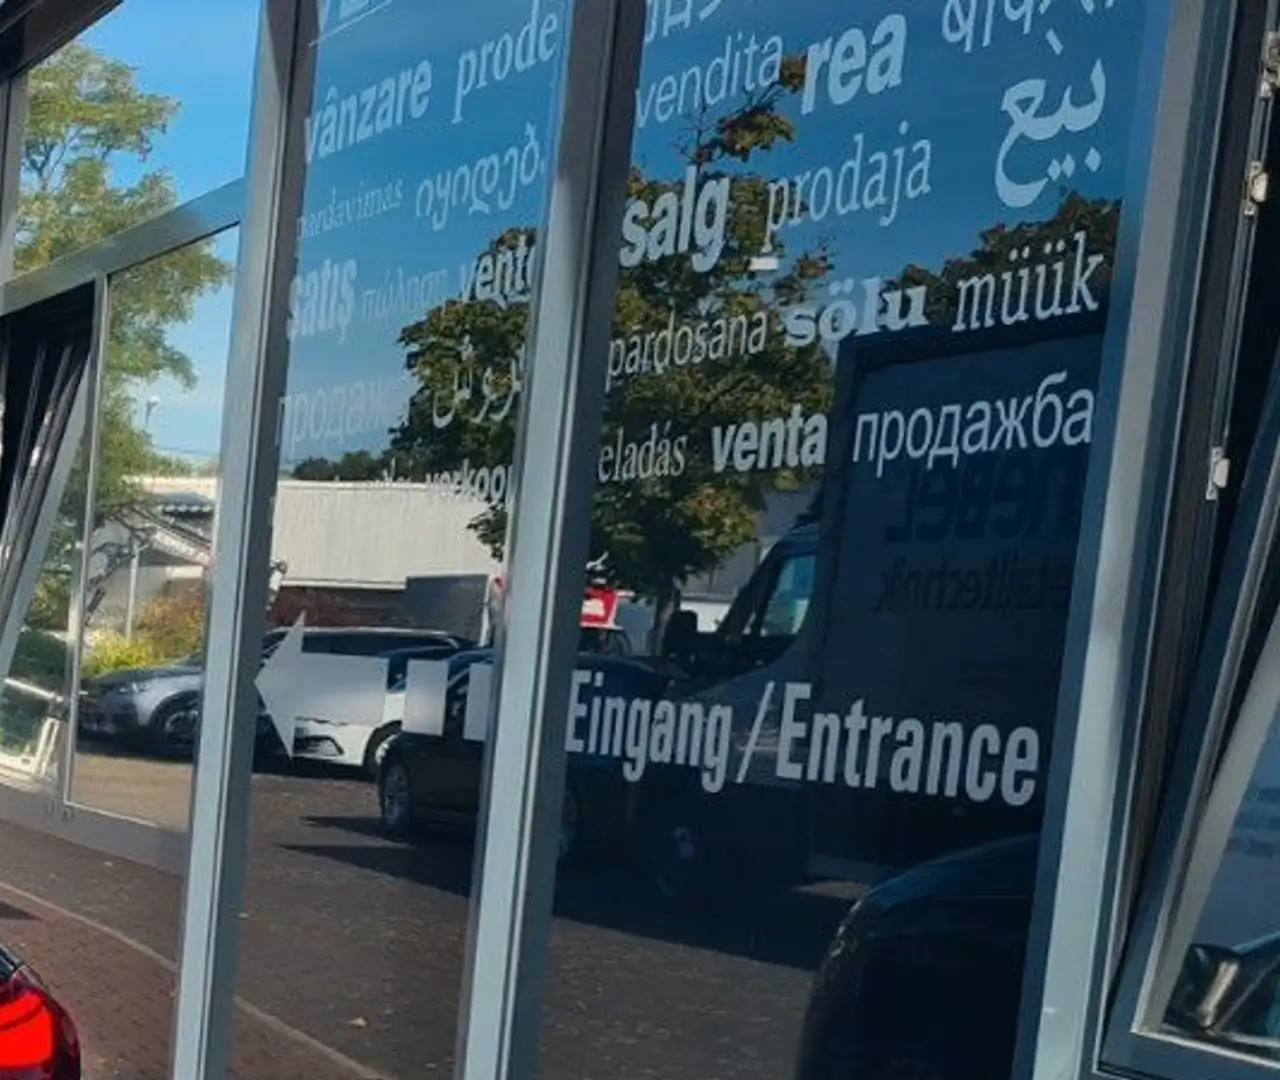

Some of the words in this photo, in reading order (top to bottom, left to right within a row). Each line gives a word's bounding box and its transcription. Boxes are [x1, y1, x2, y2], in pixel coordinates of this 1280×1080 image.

[304, 60, 432, 164] vânzare
[452, 0, 558, 123] prode
[635, 32, 783, 128] vendita
[800, 13, 908, 114] rea
[619, 165, 731, 272] salg
[761, 120, 932, 253] prodaja
[782, 276, 929, 349] sölu
[951, 231, 1104, 332] müük
[598, 420, 688, 483] eladás
[712, 403, 828, 473] venta
[852, 371, 1095, 479] продажба
